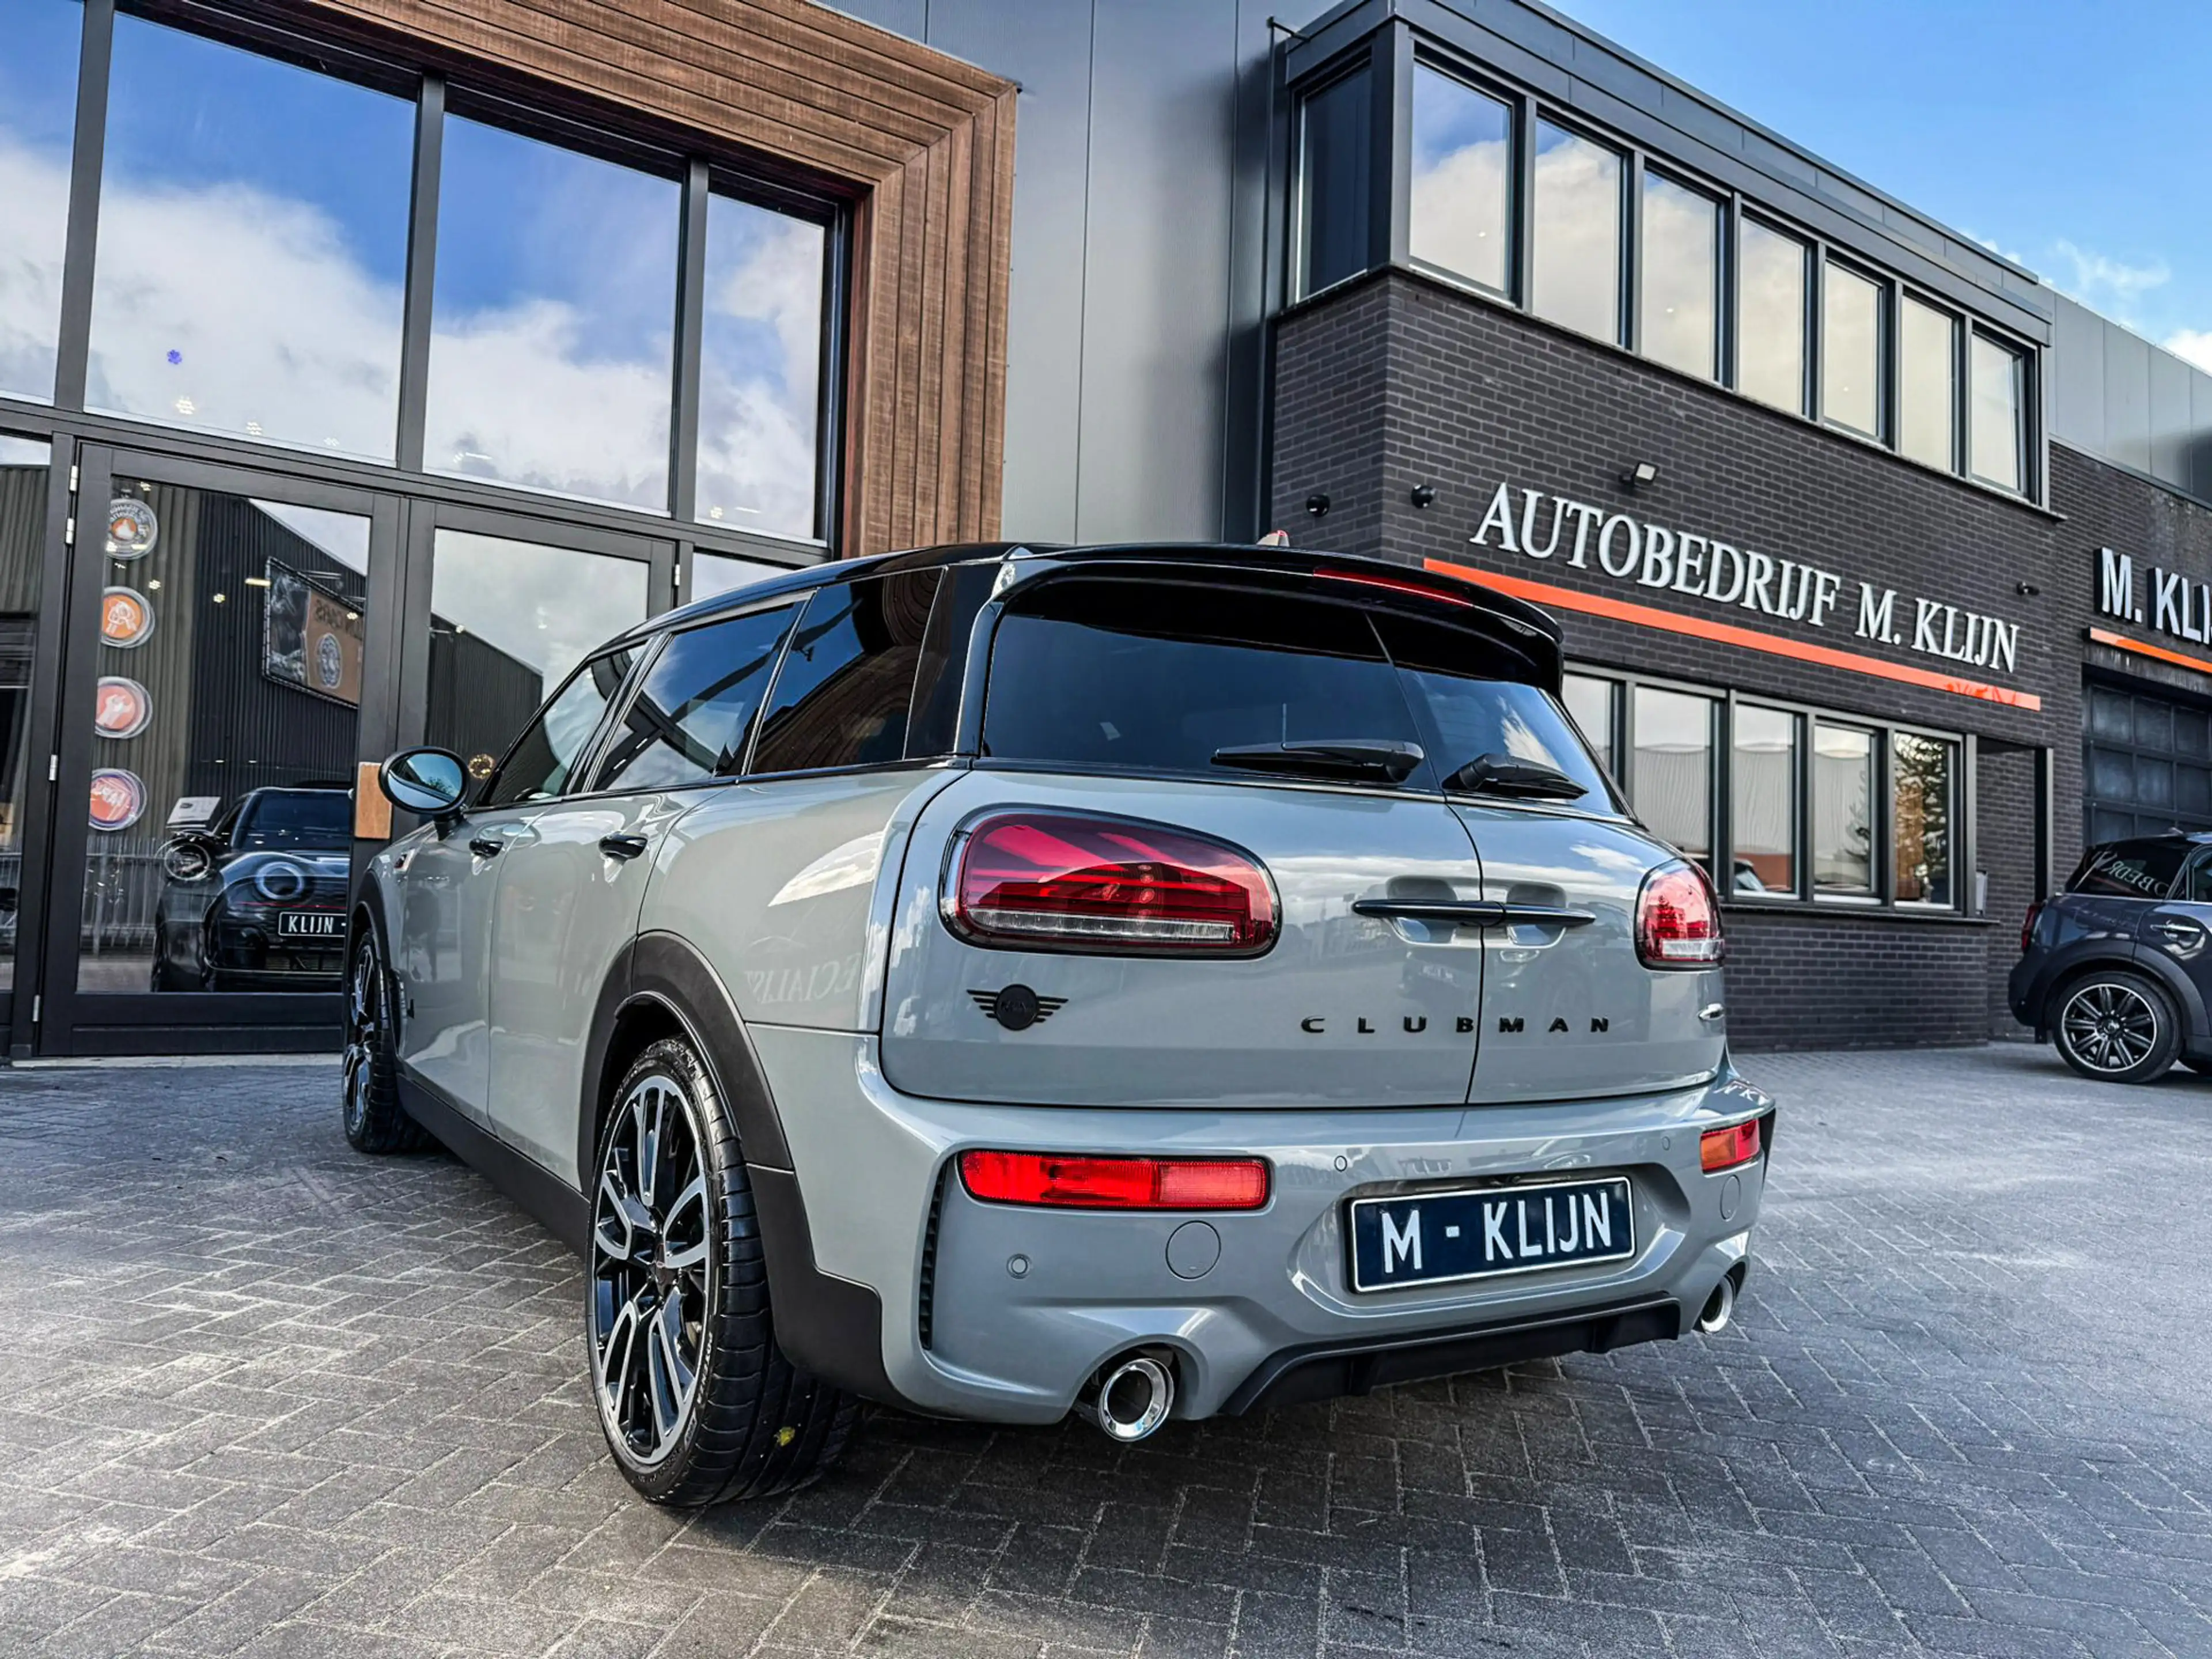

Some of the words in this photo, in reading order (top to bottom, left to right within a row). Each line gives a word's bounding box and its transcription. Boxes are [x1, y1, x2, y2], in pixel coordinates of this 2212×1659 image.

[1469, 482, 1840, 627] AUTOBEDRIJF
[1855, 582, 1902, 645] M.
[1910, 597, 2020, 674] KLIJN
[2100, 546, 2142, 624] M.
[2153, 567, 2212, 645] KLI
[288, 915, 334, 934] KLIJN
[1301, 1016, 1609, 1033] CLUBMAN
[1381, 1207, 1422, 1274] M
[1483, 1191, 1611, 1262] KLIJN
